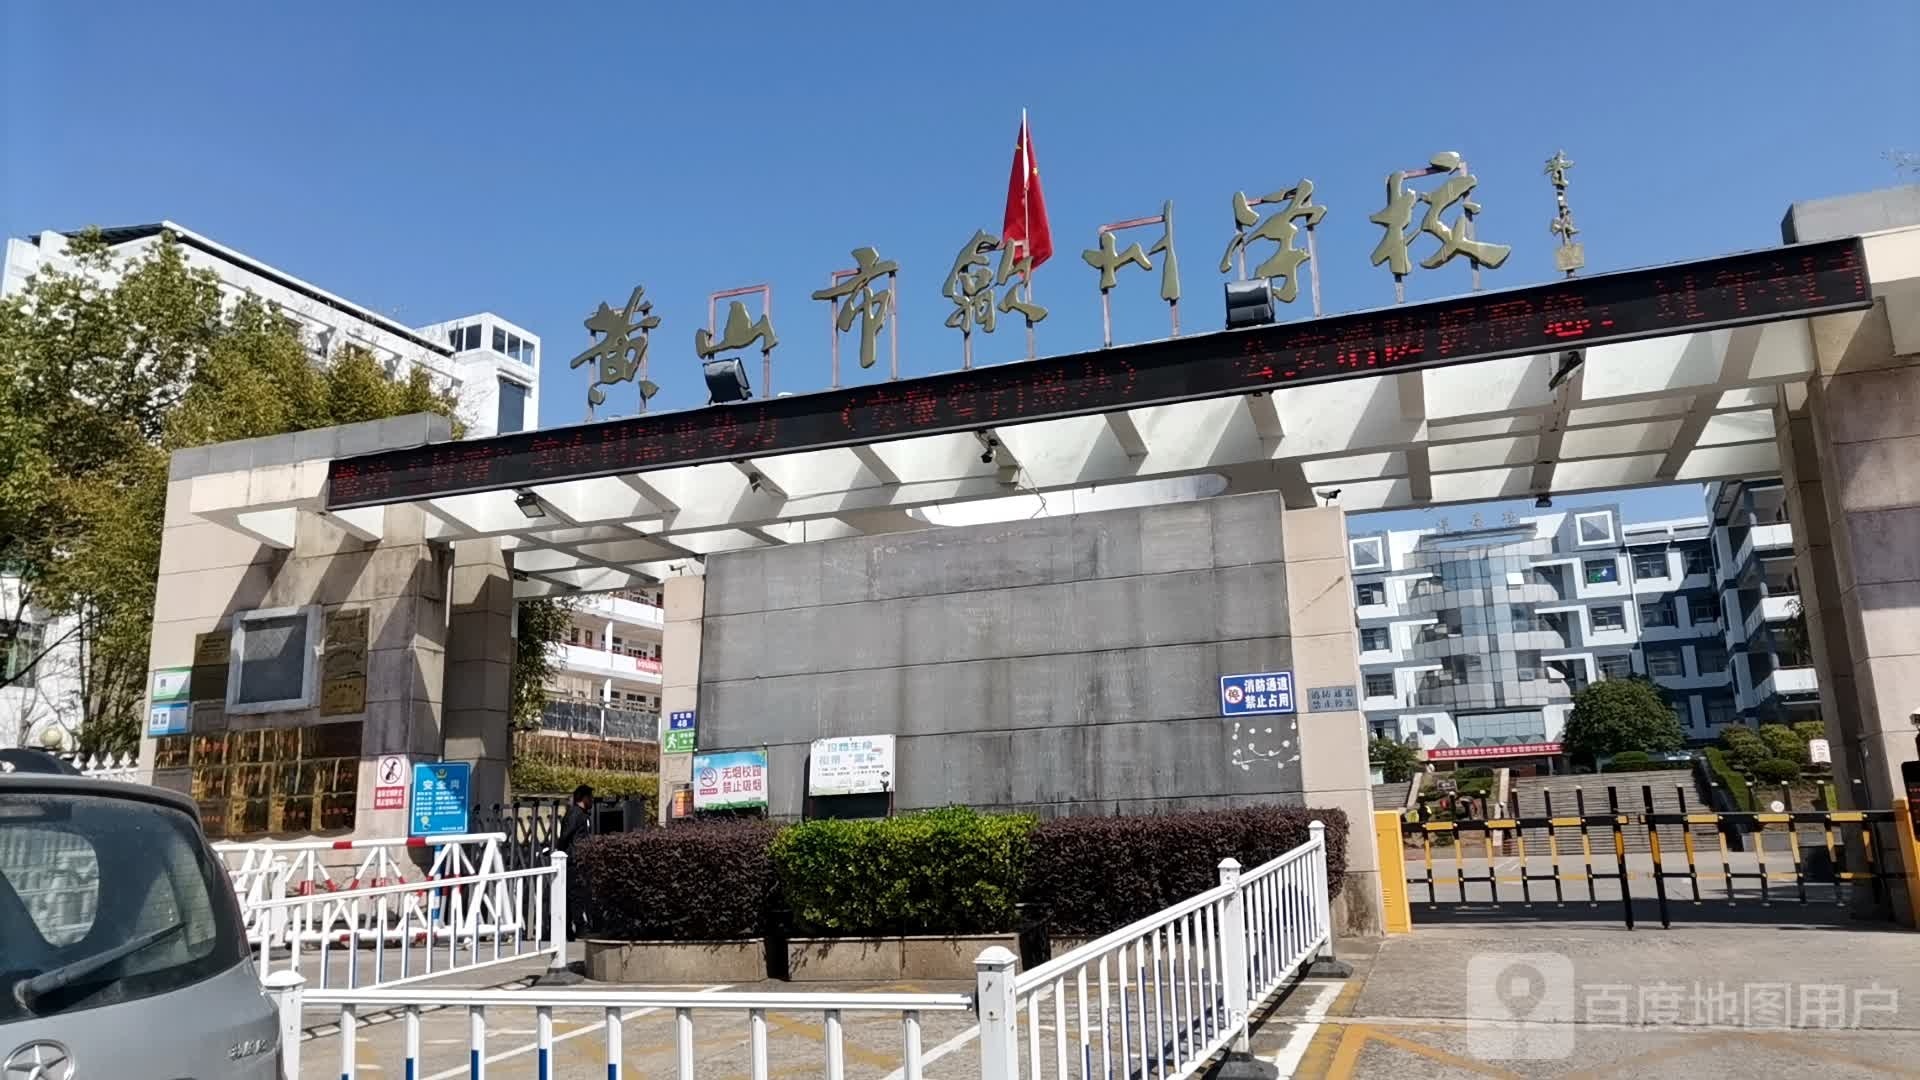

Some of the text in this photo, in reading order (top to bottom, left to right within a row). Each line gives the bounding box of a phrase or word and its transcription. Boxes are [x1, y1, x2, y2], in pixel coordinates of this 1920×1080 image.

[1244, 677, 1289, 693] 消防通道
[1245, 693, 1290, 709] 禁止占用
[722, 765, 762, 779] 无烟校园
[723, 779, 762, 793] 禁止吸烟
